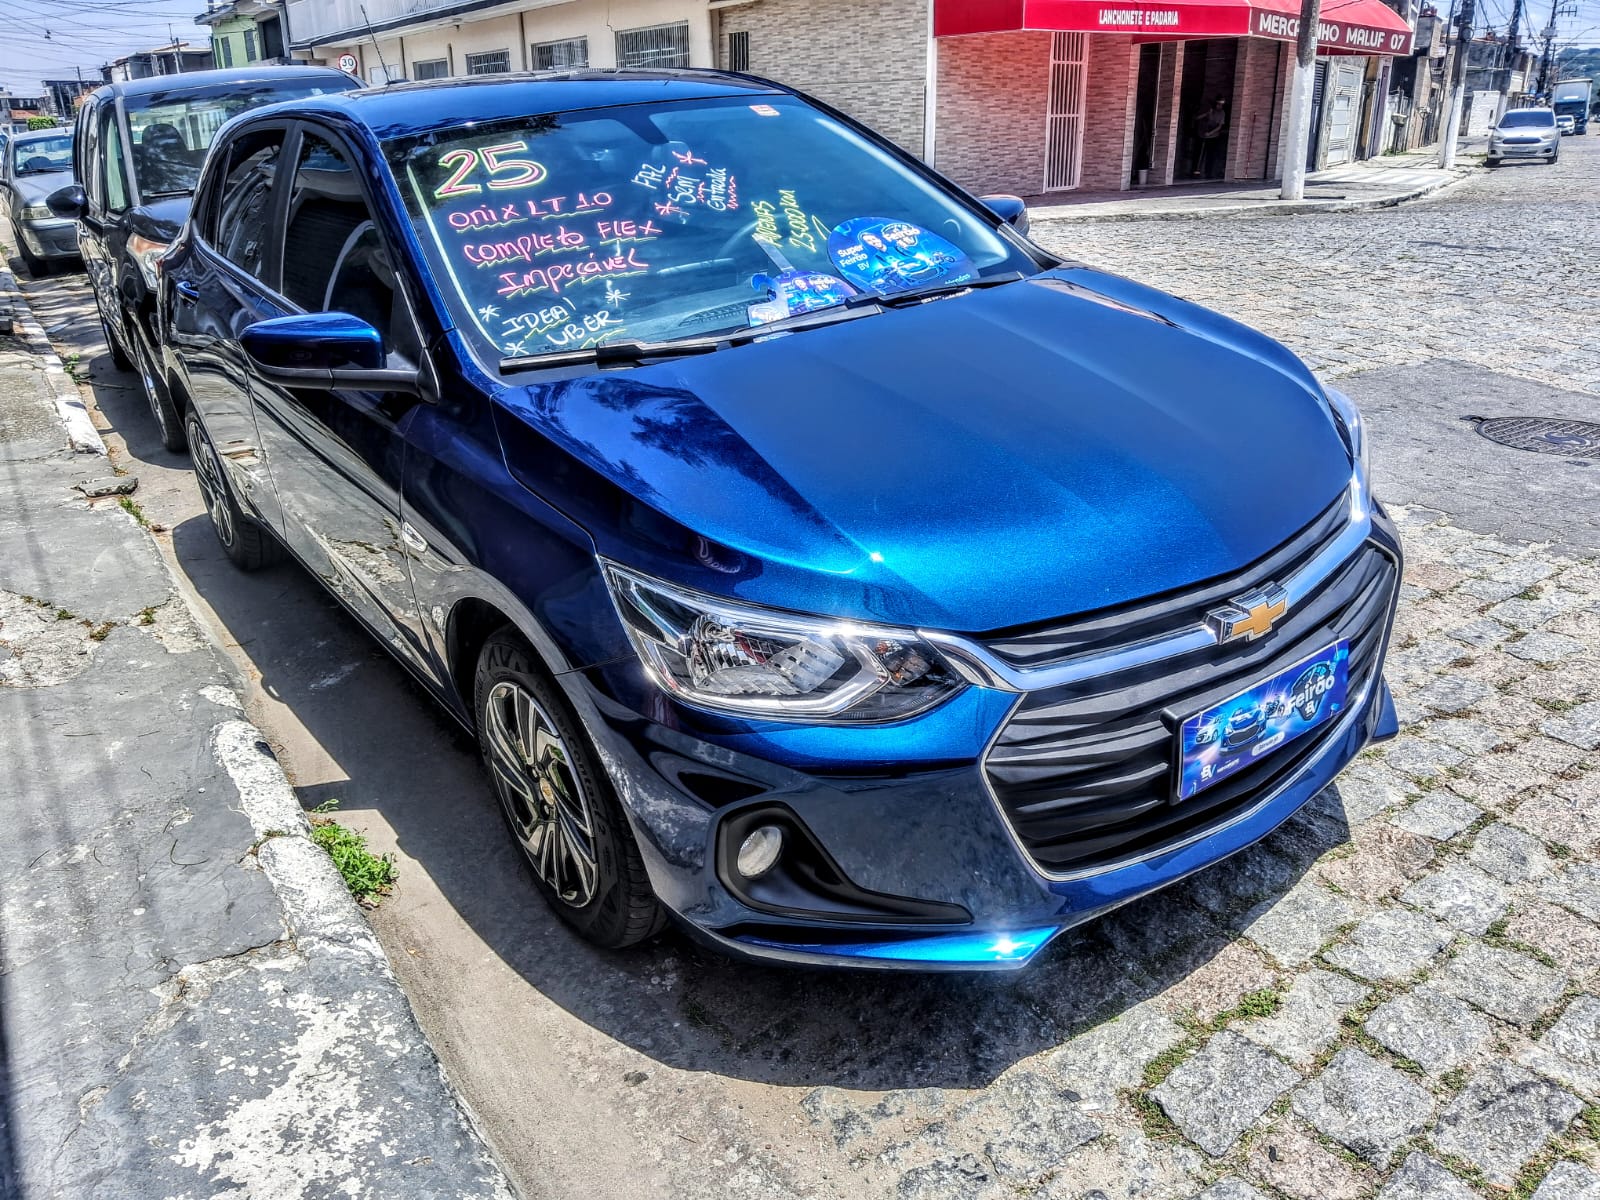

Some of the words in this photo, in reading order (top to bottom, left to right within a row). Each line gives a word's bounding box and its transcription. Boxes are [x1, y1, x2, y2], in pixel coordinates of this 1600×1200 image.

[1099, 9, 1143, 25] LANCHONETE
[1145, 11, 1151, 25] E
[1151, 11, 1179, 25] PADARIA
[1346, 27, 1386, 48] MALUF
[1390, 35, 1406, 50] 07
[341, 58, 354, 67] 30
[434, 140, 547, 199] 25
[527, 196, 567, 217] LT
[575, 191, 613, 210] 1.0
[837, 245, 864, 258] Super
[839, 253, 868, 268] Feirão
[857, 261, 870, 271] BV
[546, 310, 624, 346] UBER
[1283, 674, 1335, 717] Feirão
